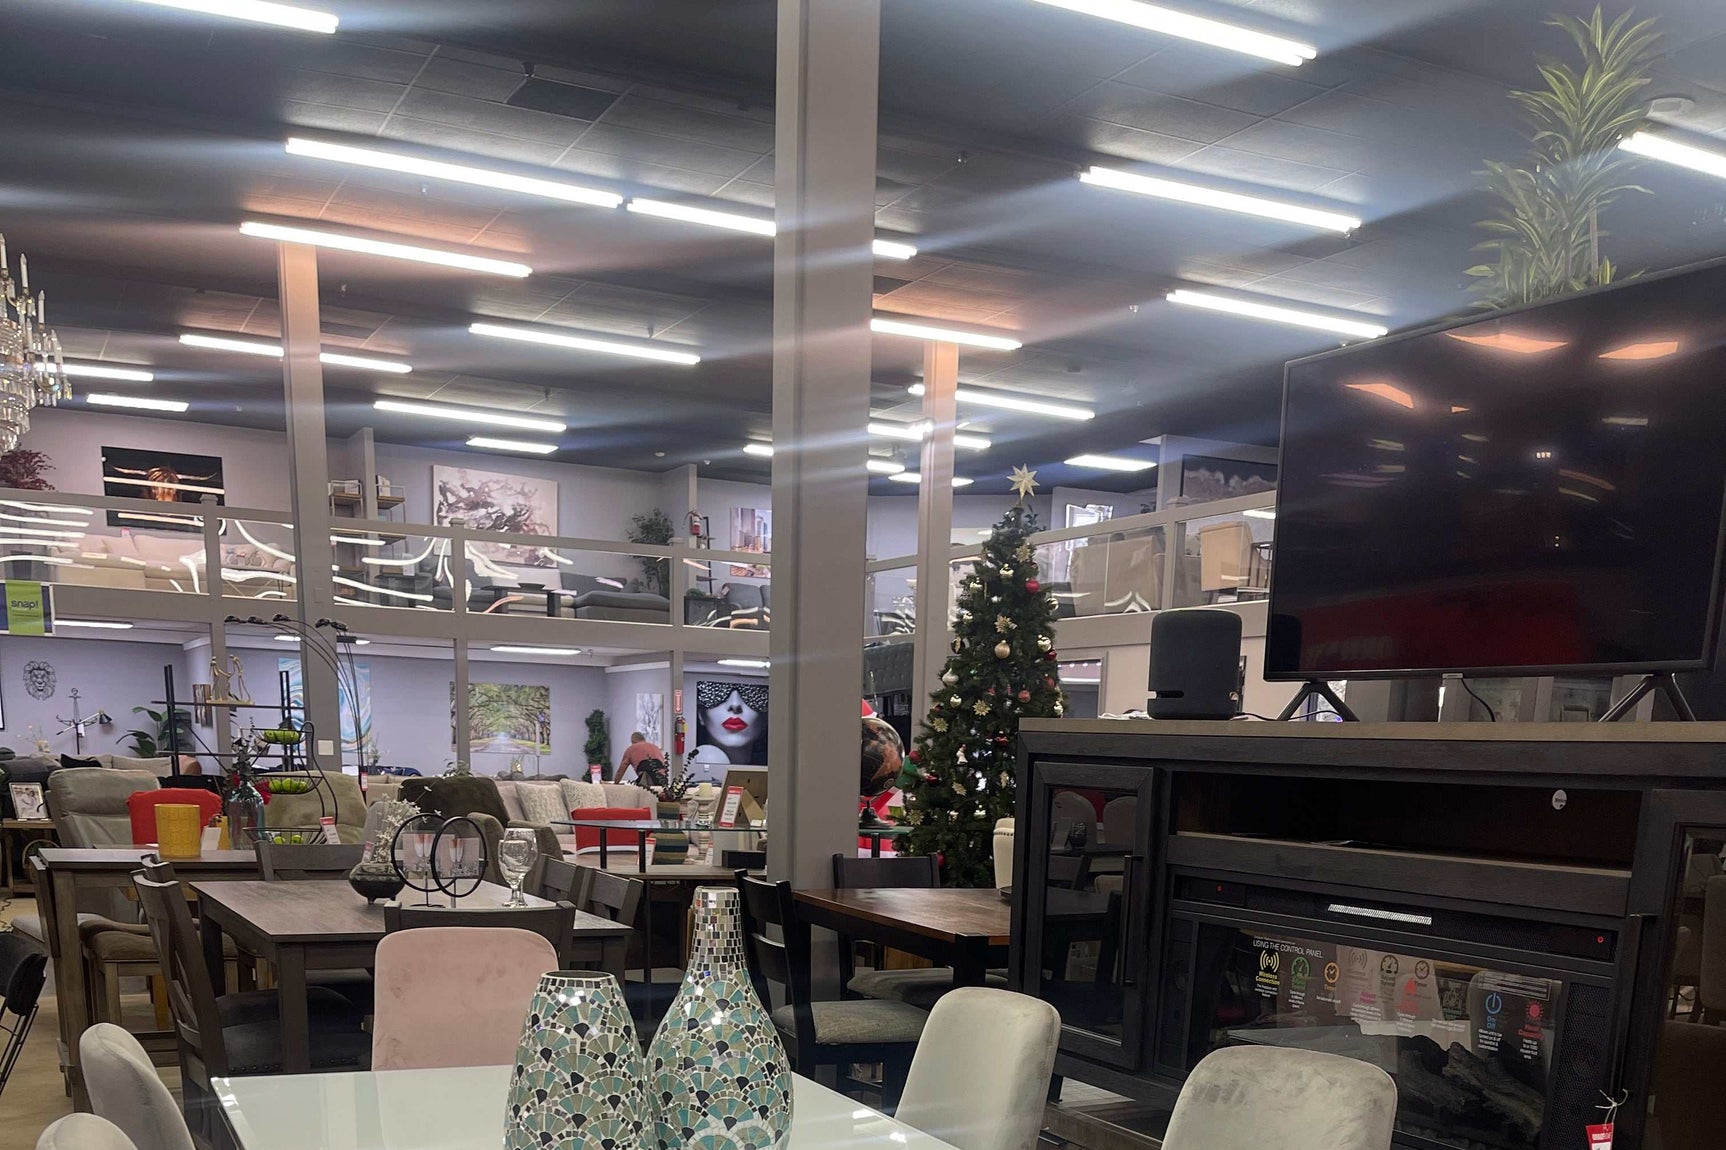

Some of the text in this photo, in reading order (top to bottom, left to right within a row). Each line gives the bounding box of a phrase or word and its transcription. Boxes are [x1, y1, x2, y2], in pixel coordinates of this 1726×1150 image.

[11, 600, 38, 610] snap!
[1253, 940, 1269, 949] USING
[1269, 942, 1280, 951] THE
[1280, 944, 1304, 955] CONTROL
